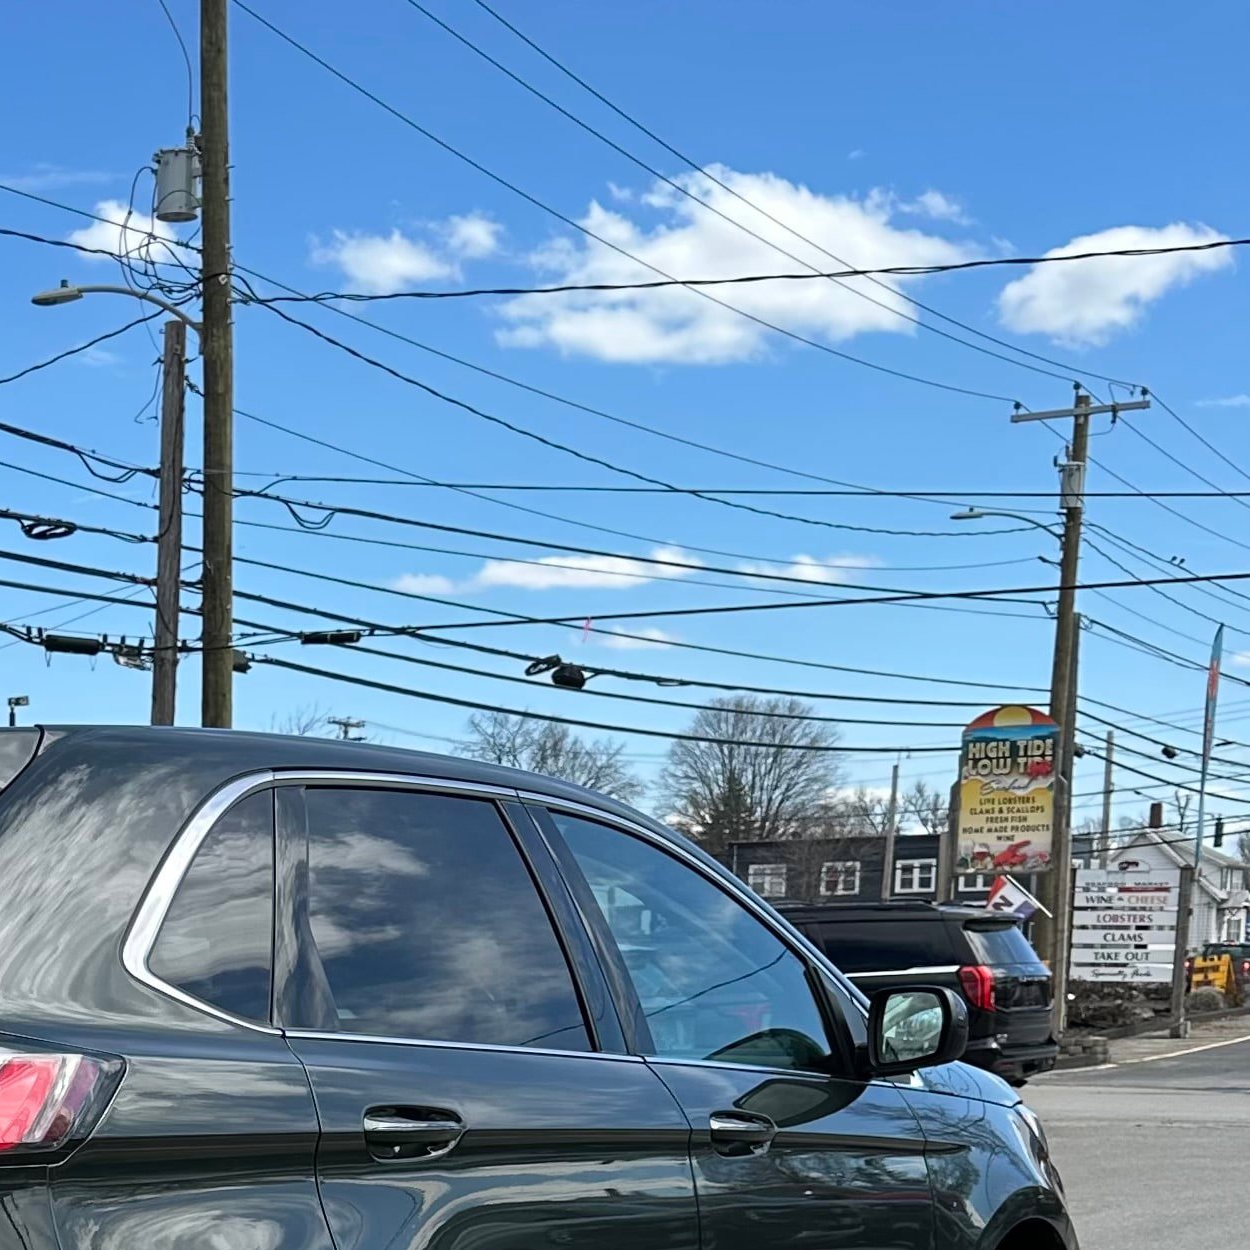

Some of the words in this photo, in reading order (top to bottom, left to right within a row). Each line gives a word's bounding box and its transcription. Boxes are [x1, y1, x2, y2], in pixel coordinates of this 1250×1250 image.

[968, 741, 1011, 759] HIGH
[1016, 738, 1054, 756] TIDE
[968, 757, 1012, 776] LOW
[979, 798, 995, 806] LIVE
[997, 796, 1036, 805] LOBSTERS
[969, 807, 995, 815] CLAMS
[1006, 805, 1045, 814] SCALLOPS
[985, 816, 1009, 824] FRESH
[962, 826, 985, 834] HOME
[1010, 824, 1050, 833] PRODUCTS
[996, 834, 1015, 842] WINE
[1085, 895, 1113, 904] WINE
[1127, 895, 1168, 904] CHEESE
[1096, 913, 1153, 923] LOBSTERS
[1102, 932, 1144, 942] CLAMS
[1093, 952, 1121, 961] TAKE
[1124, 951, 1151, 961] OUT
